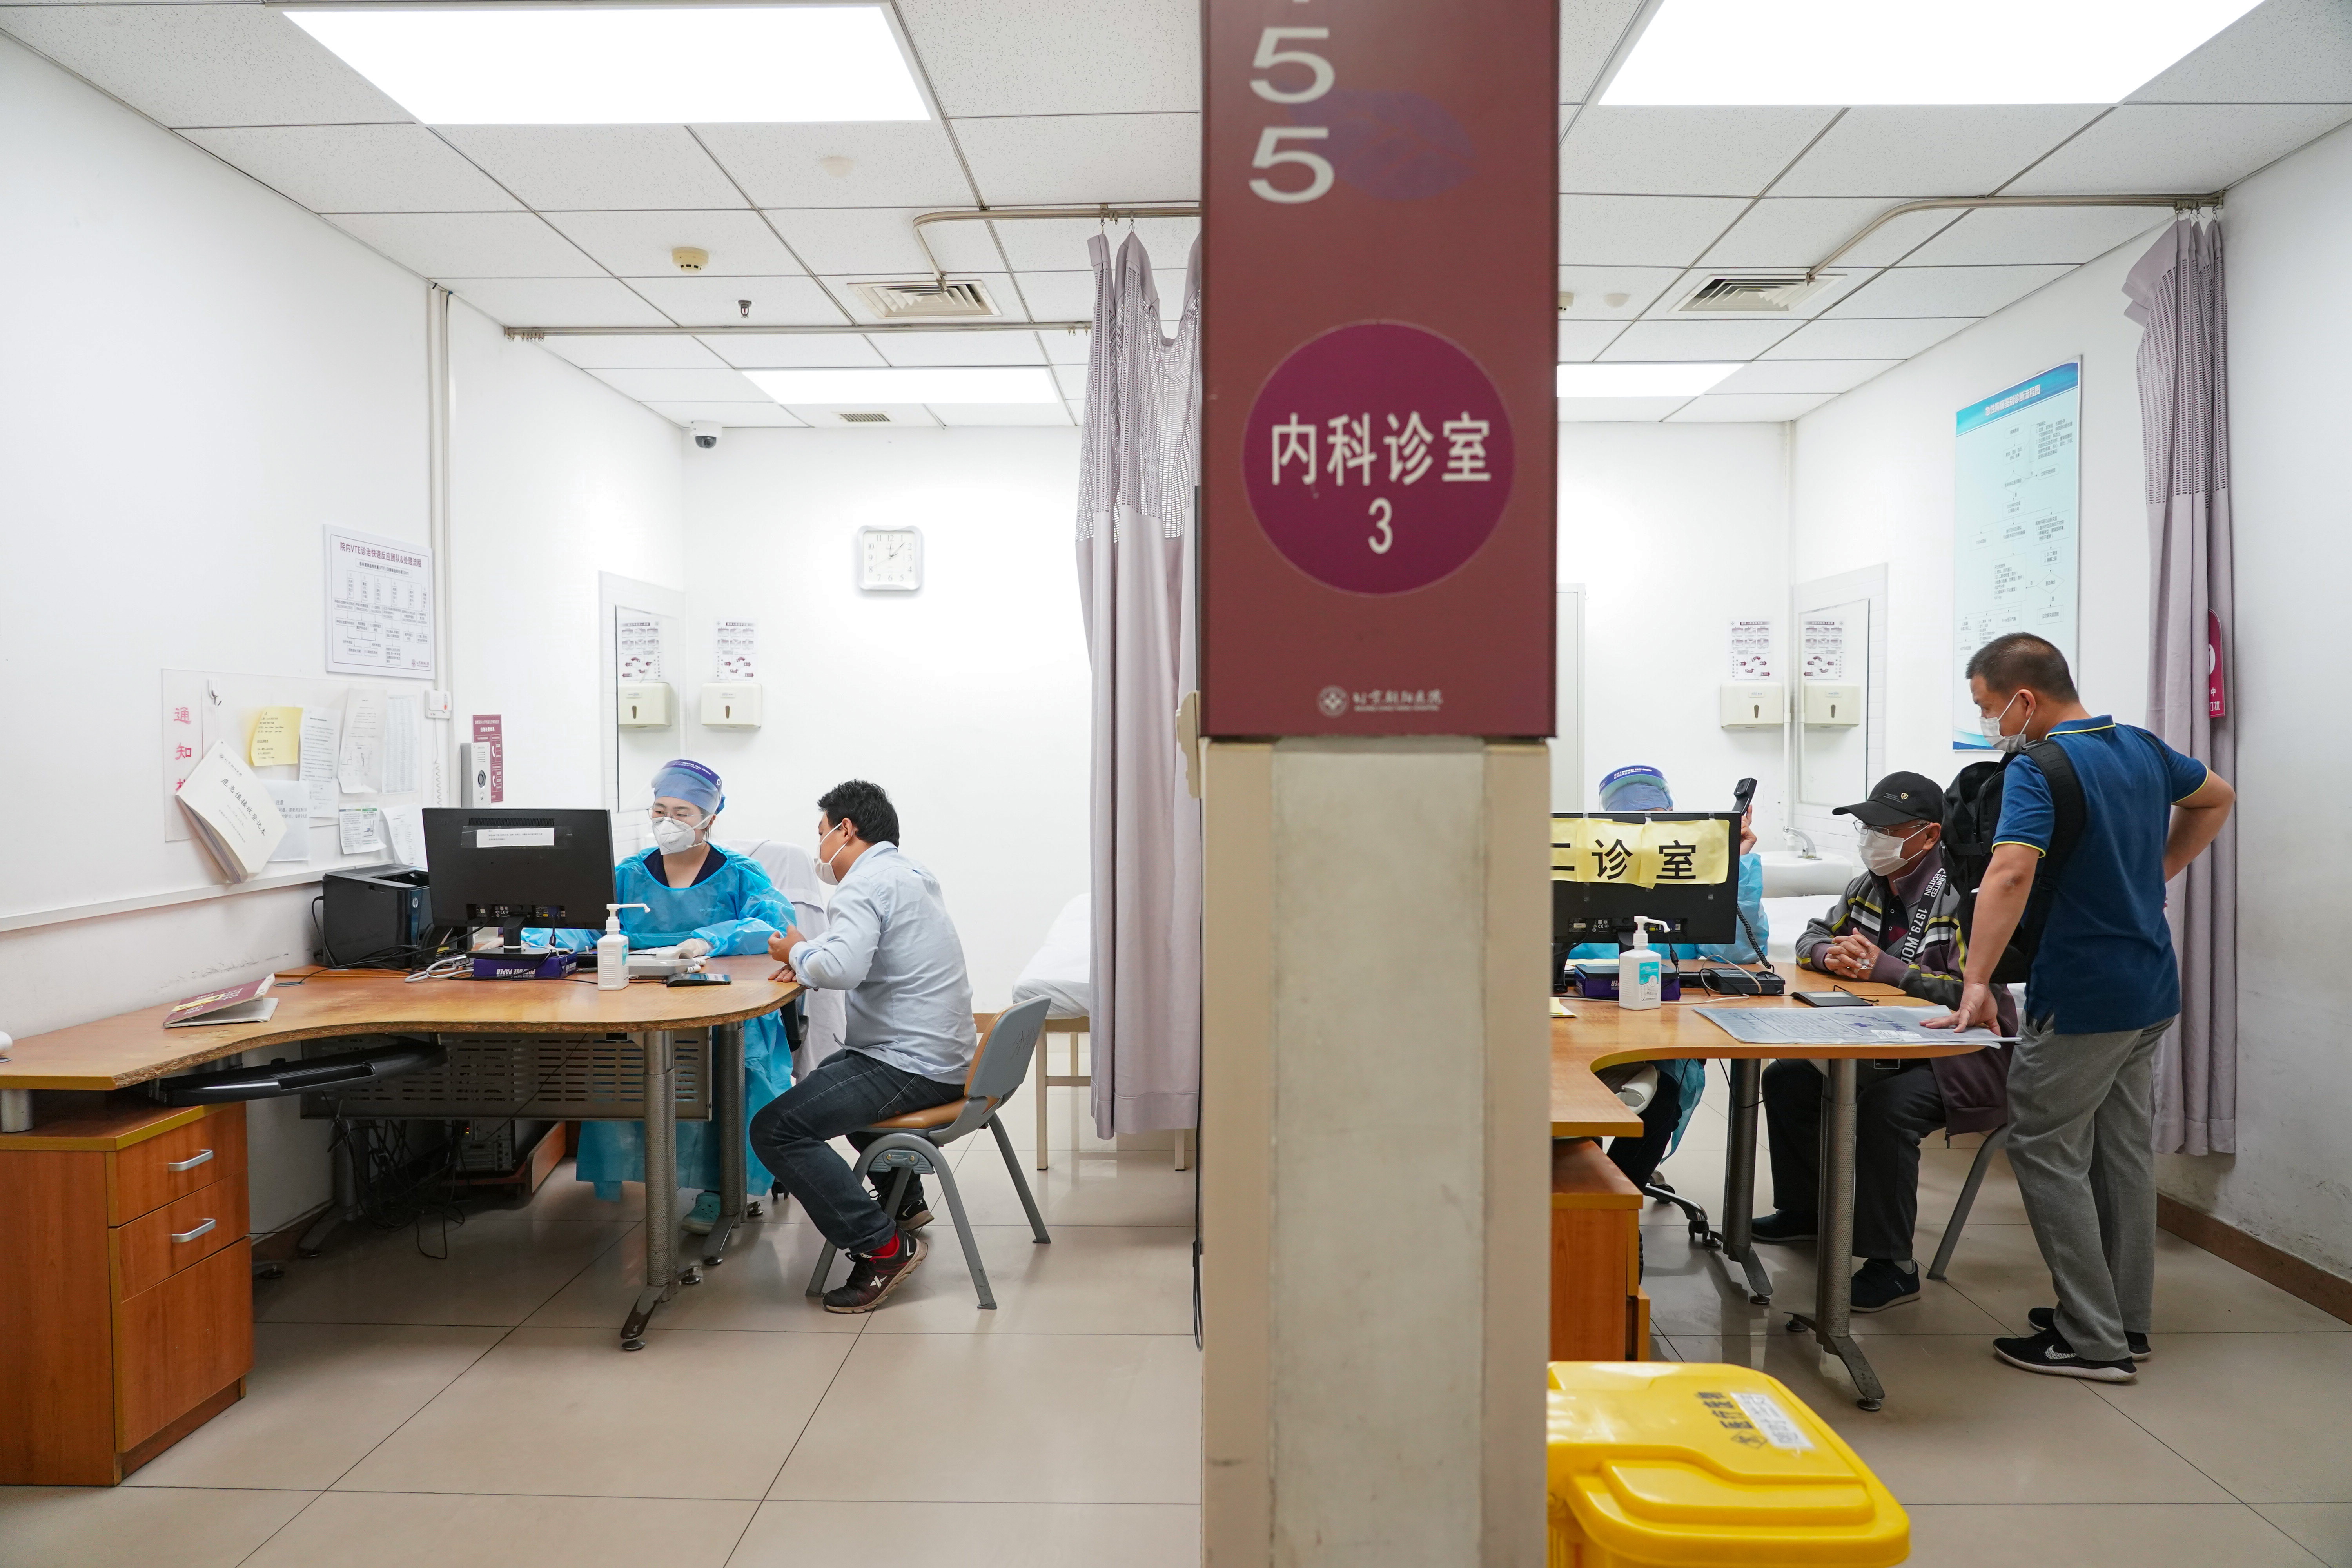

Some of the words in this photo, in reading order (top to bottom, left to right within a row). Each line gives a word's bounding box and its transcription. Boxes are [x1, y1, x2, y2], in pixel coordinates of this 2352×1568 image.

[1249, 27, 1335, 104] 5
[1249, 127, 1334, 204] 5
[1271, 411, 1491, 486] 内科诊室
[1368, 497, 1393, 554] 3
[221, 779, 266, 836] 危急值接收登记本
[1551, 839, 1696, 880] 二诊室
[1924, 873, 1939, 896] EDITION
[1931, 874, 1947, 897] LIMITED
